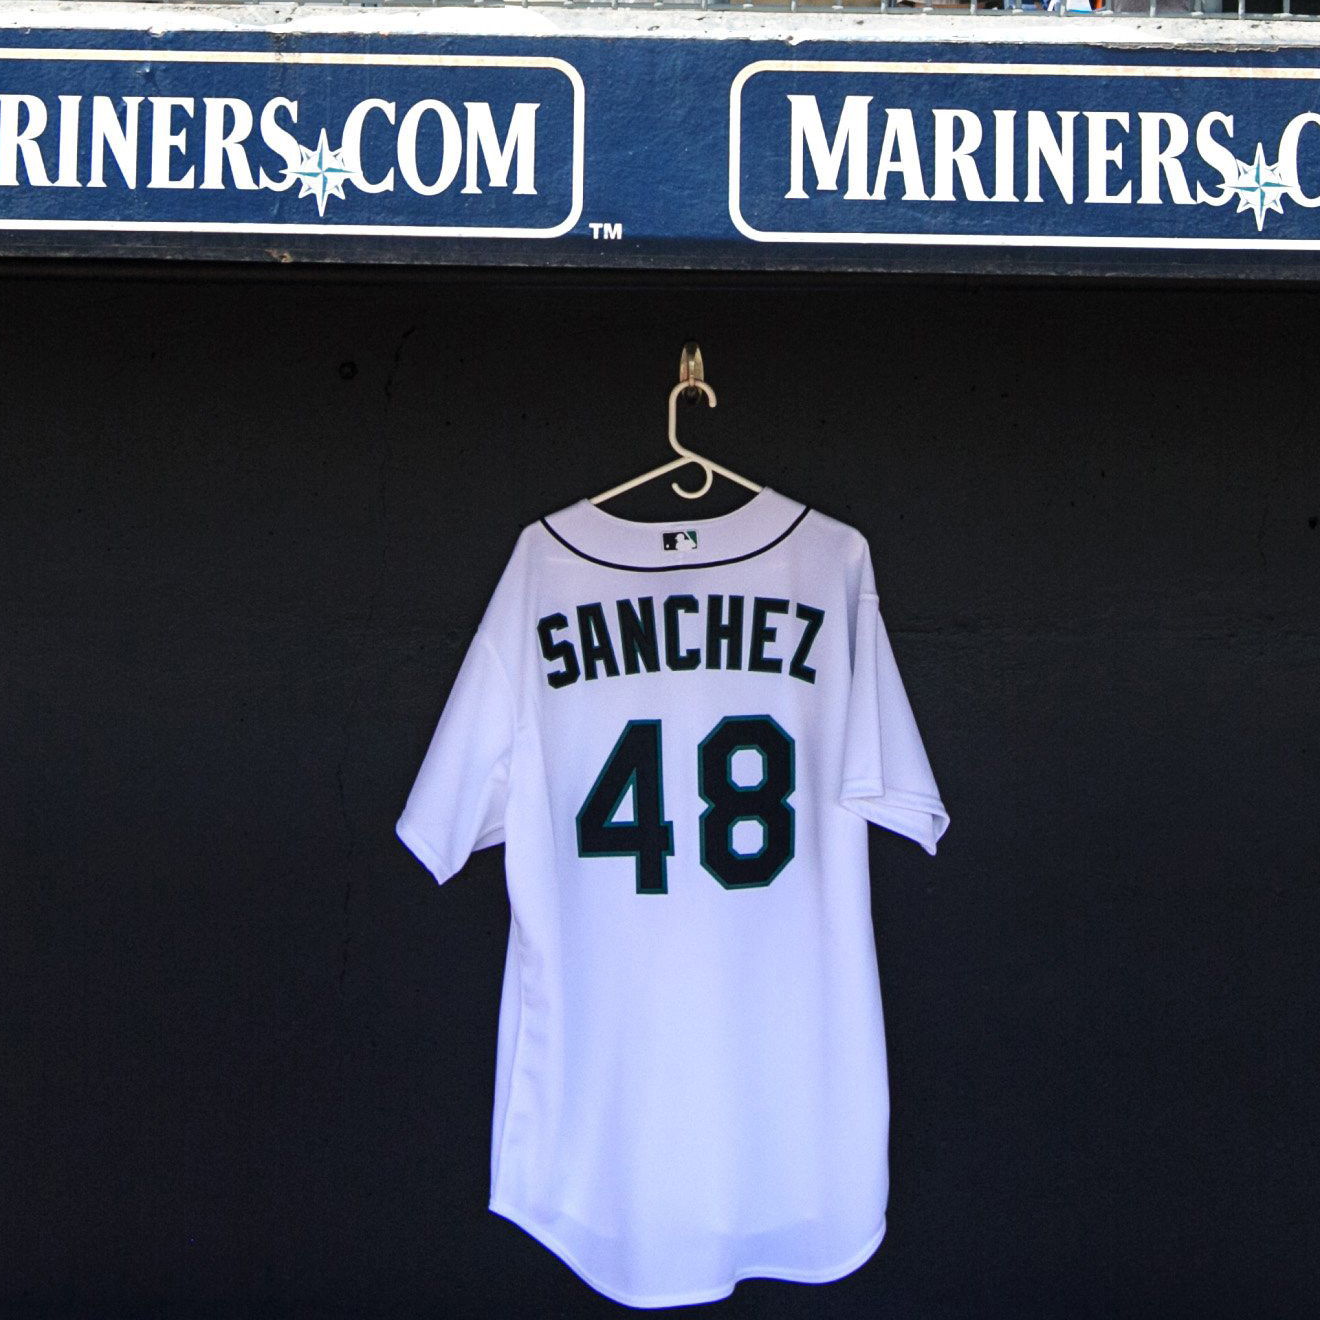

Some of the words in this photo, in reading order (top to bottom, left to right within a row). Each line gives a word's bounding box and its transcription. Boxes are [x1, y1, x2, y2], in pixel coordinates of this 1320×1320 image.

[589, 223, 623, 240] TM
[538, 593, 826, 689] SANCHEZ
[574, 714, 796, 895] 48
